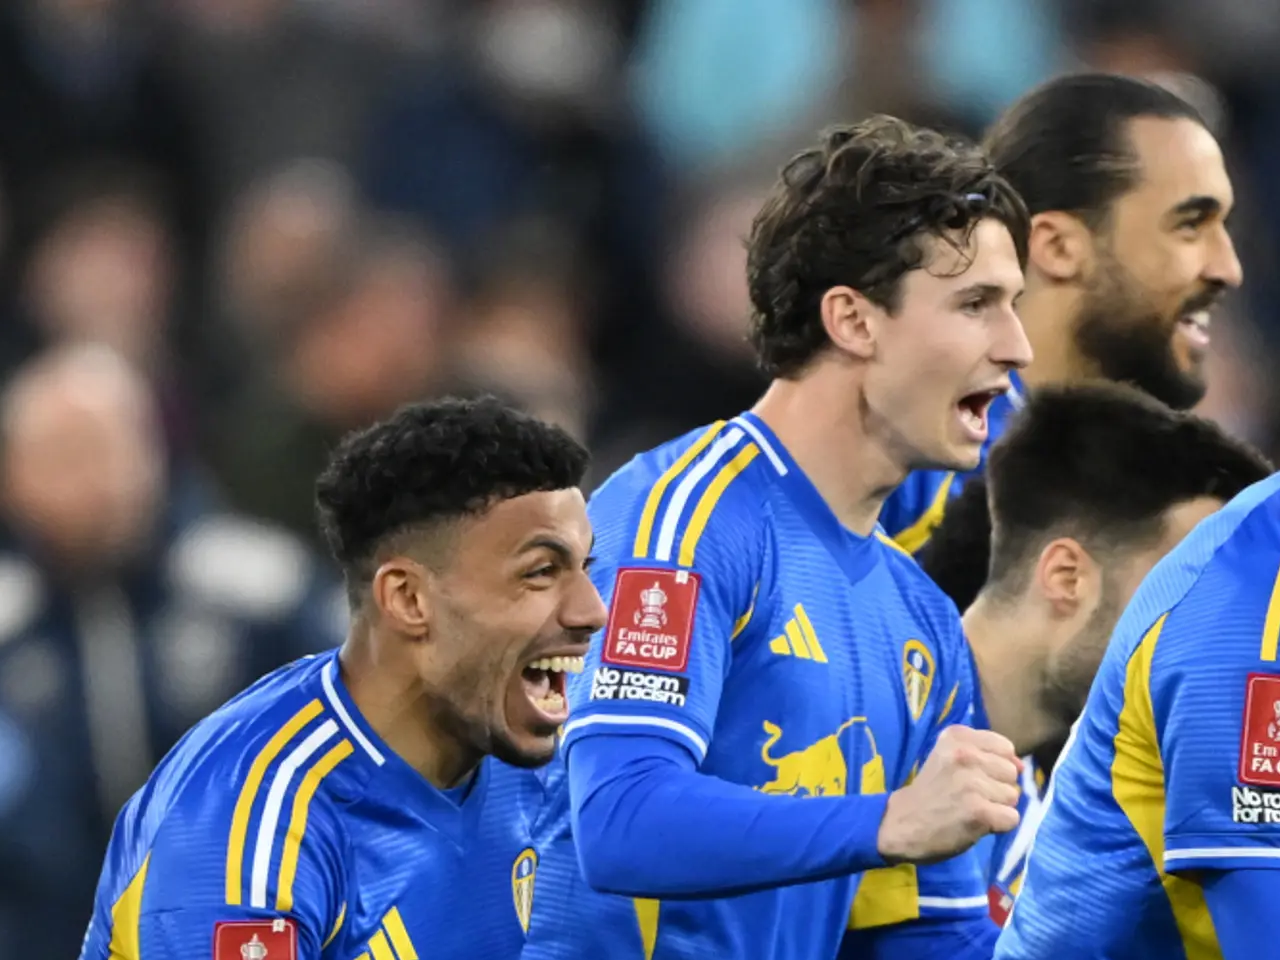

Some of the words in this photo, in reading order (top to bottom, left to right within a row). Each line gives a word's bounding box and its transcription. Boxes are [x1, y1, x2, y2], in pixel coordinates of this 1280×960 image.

[618, 627, 678, 646] Emirates
[616, 641, 637, 656] FA
[639, 643, 677, 660] CUP
[593, 667, 621, 685] No
[622, 671, 680, 692] room
[619, 685, 686, 707] racism
[1252, 757, 1274, 773] FA
[1232, 786, 1262, 806] No
[1232, 804, 1263, 823] for
